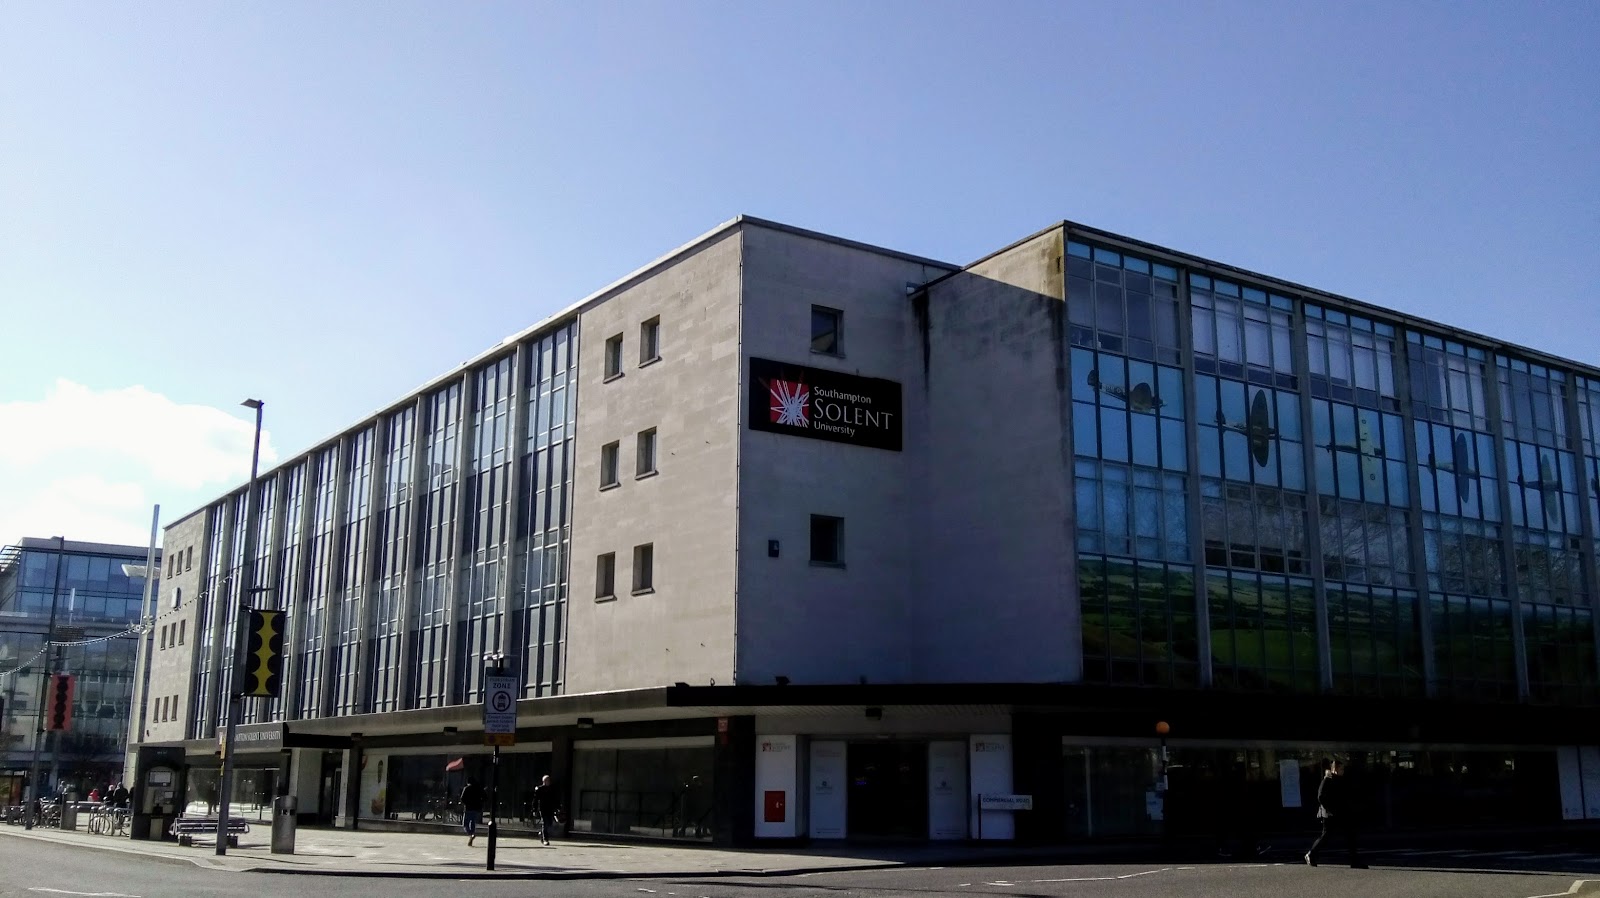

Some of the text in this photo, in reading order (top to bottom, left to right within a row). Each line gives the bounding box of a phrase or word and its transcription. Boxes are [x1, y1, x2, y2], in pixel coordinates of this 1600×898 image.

[813, 386, 872, 404] Southampton
[813, 398, 894, 430] SOLENT
[813, 420, 856, 438] University
